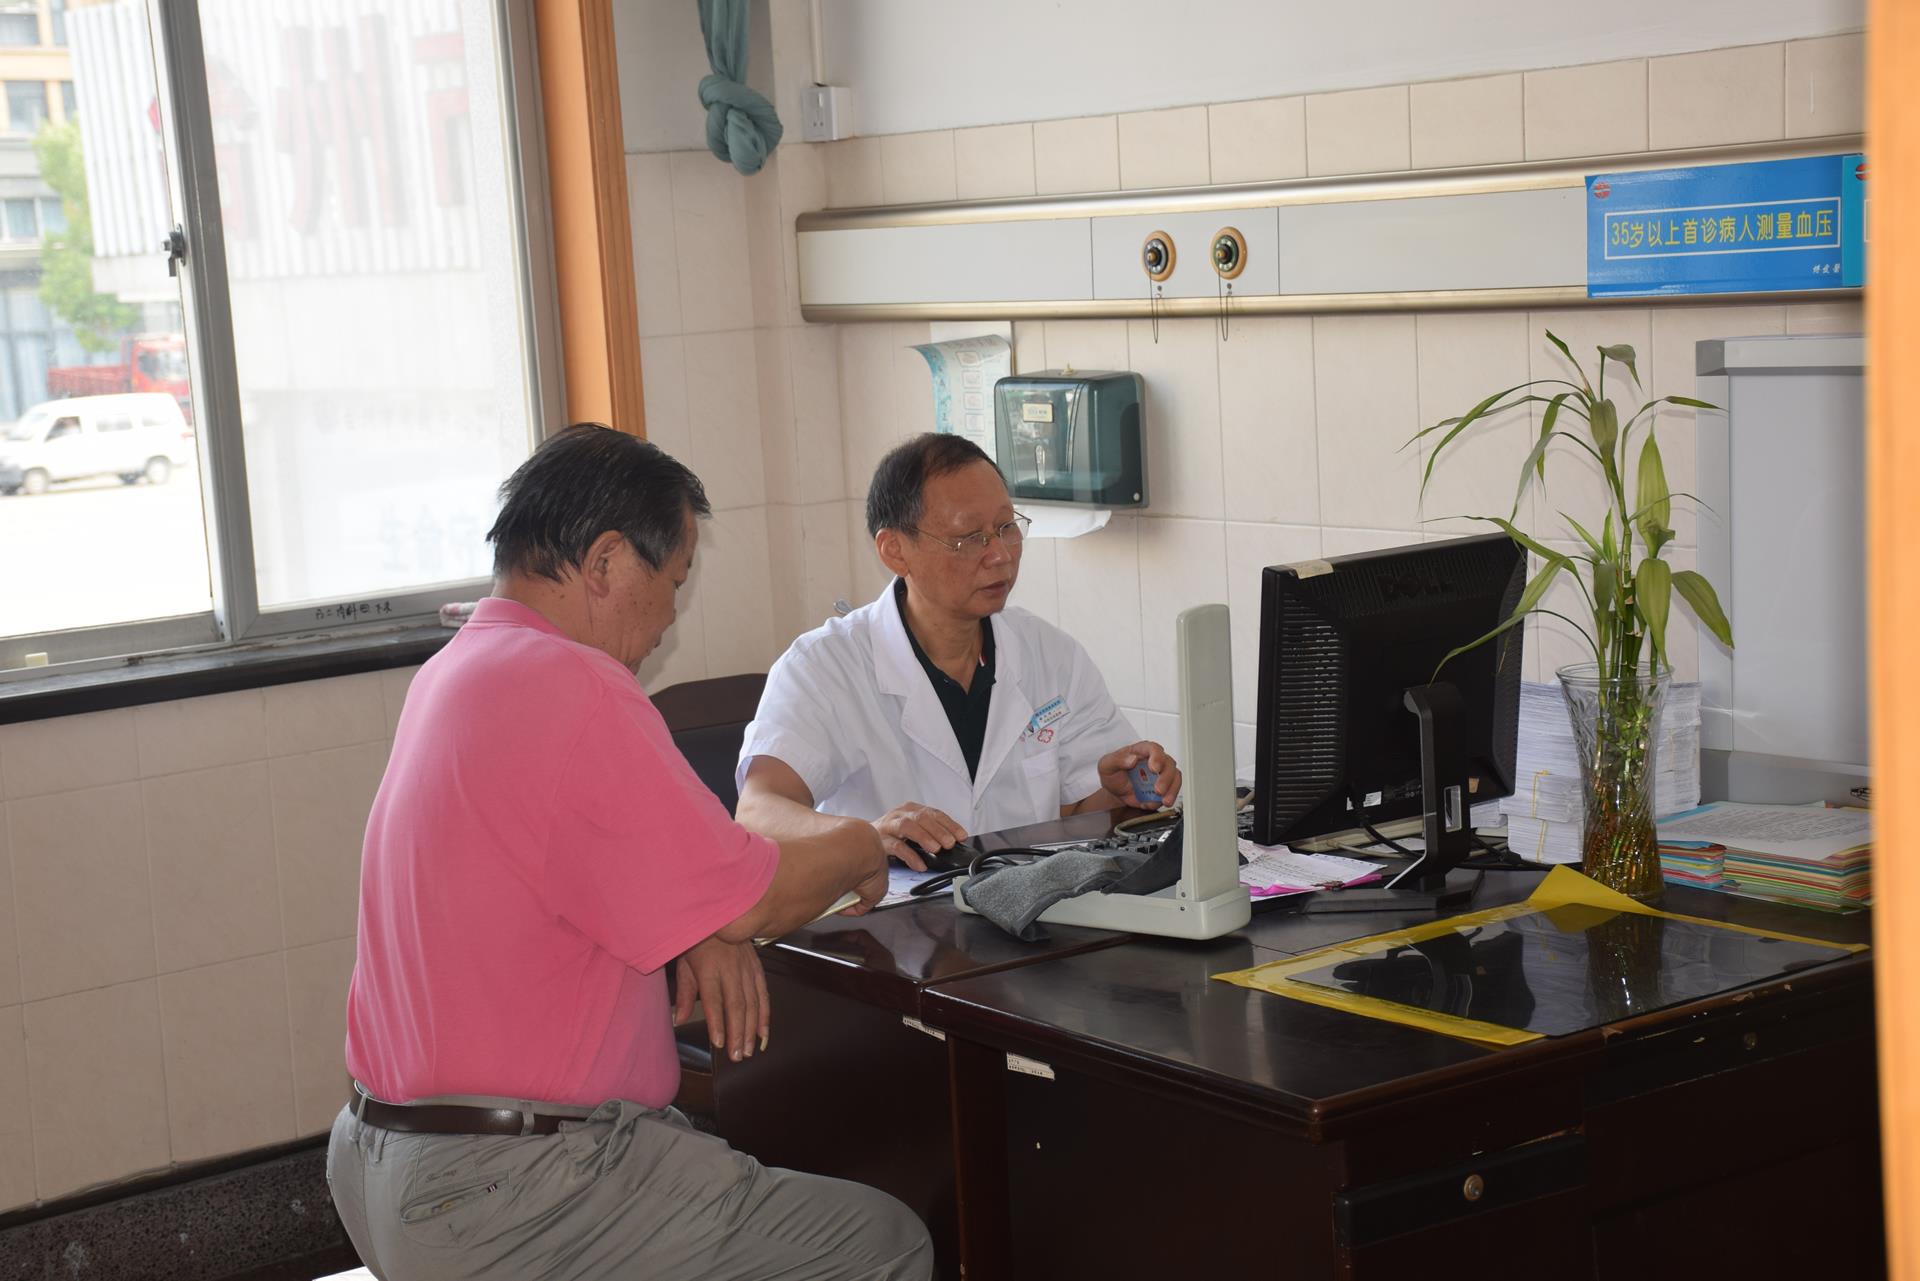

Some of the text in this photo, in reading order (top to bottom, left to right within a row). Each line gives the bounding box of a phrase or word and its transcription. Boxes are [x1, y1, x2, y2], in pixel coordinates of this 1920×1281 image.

[1611, 209, 1834, 249] 35岁以上首诊病人测量血压
